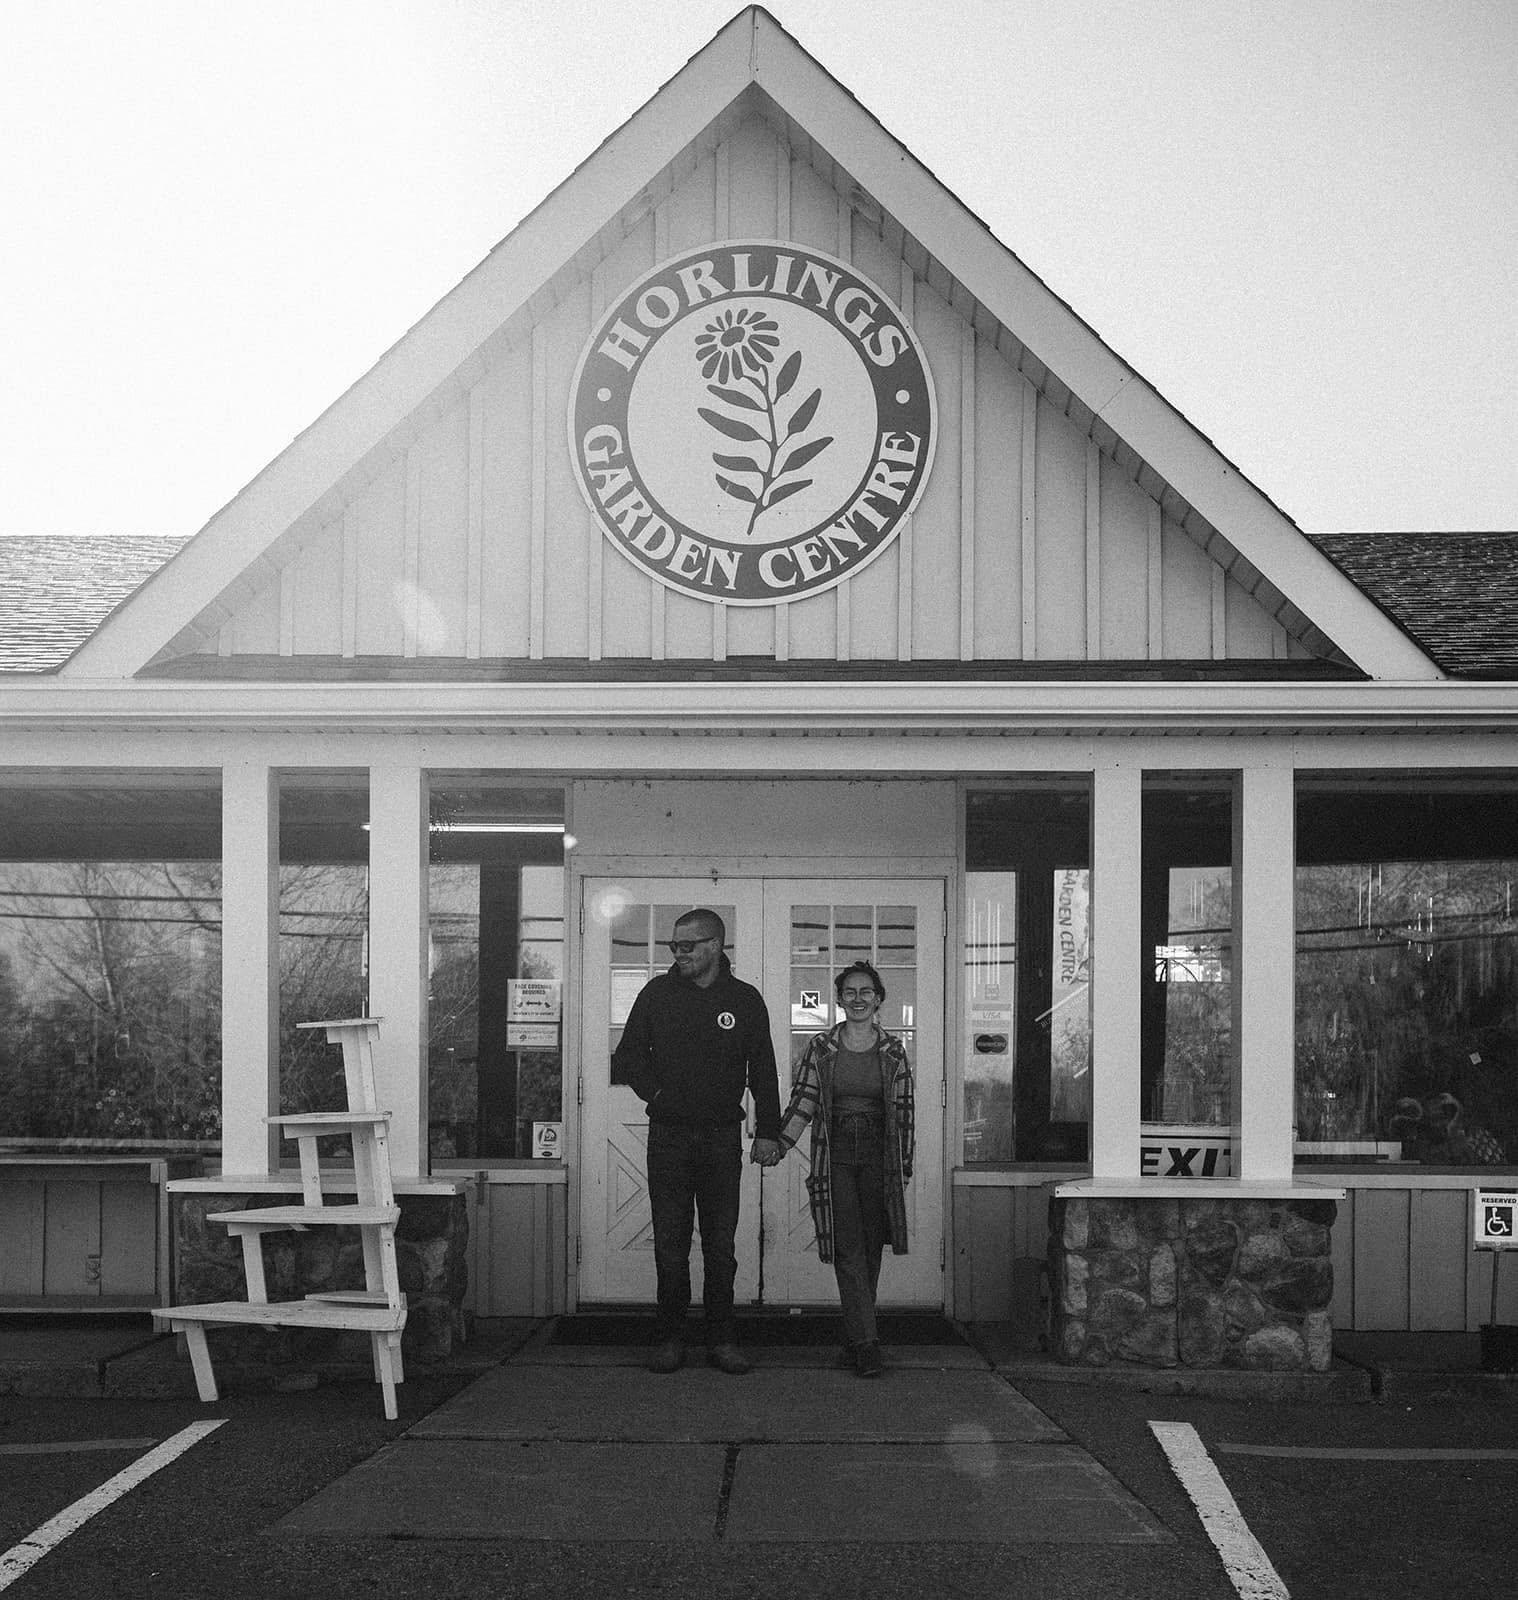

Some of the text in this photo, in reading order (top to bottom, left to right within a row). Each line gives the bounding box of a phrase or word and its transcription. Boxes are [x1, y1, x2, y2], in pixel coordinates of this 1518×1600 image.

[598, 253, 909, 372] HORLINGS
[583, 424, 921, 590] GARDEN CENTRE
[1059, 870, 1079, 983] GARDEN CENTRE
